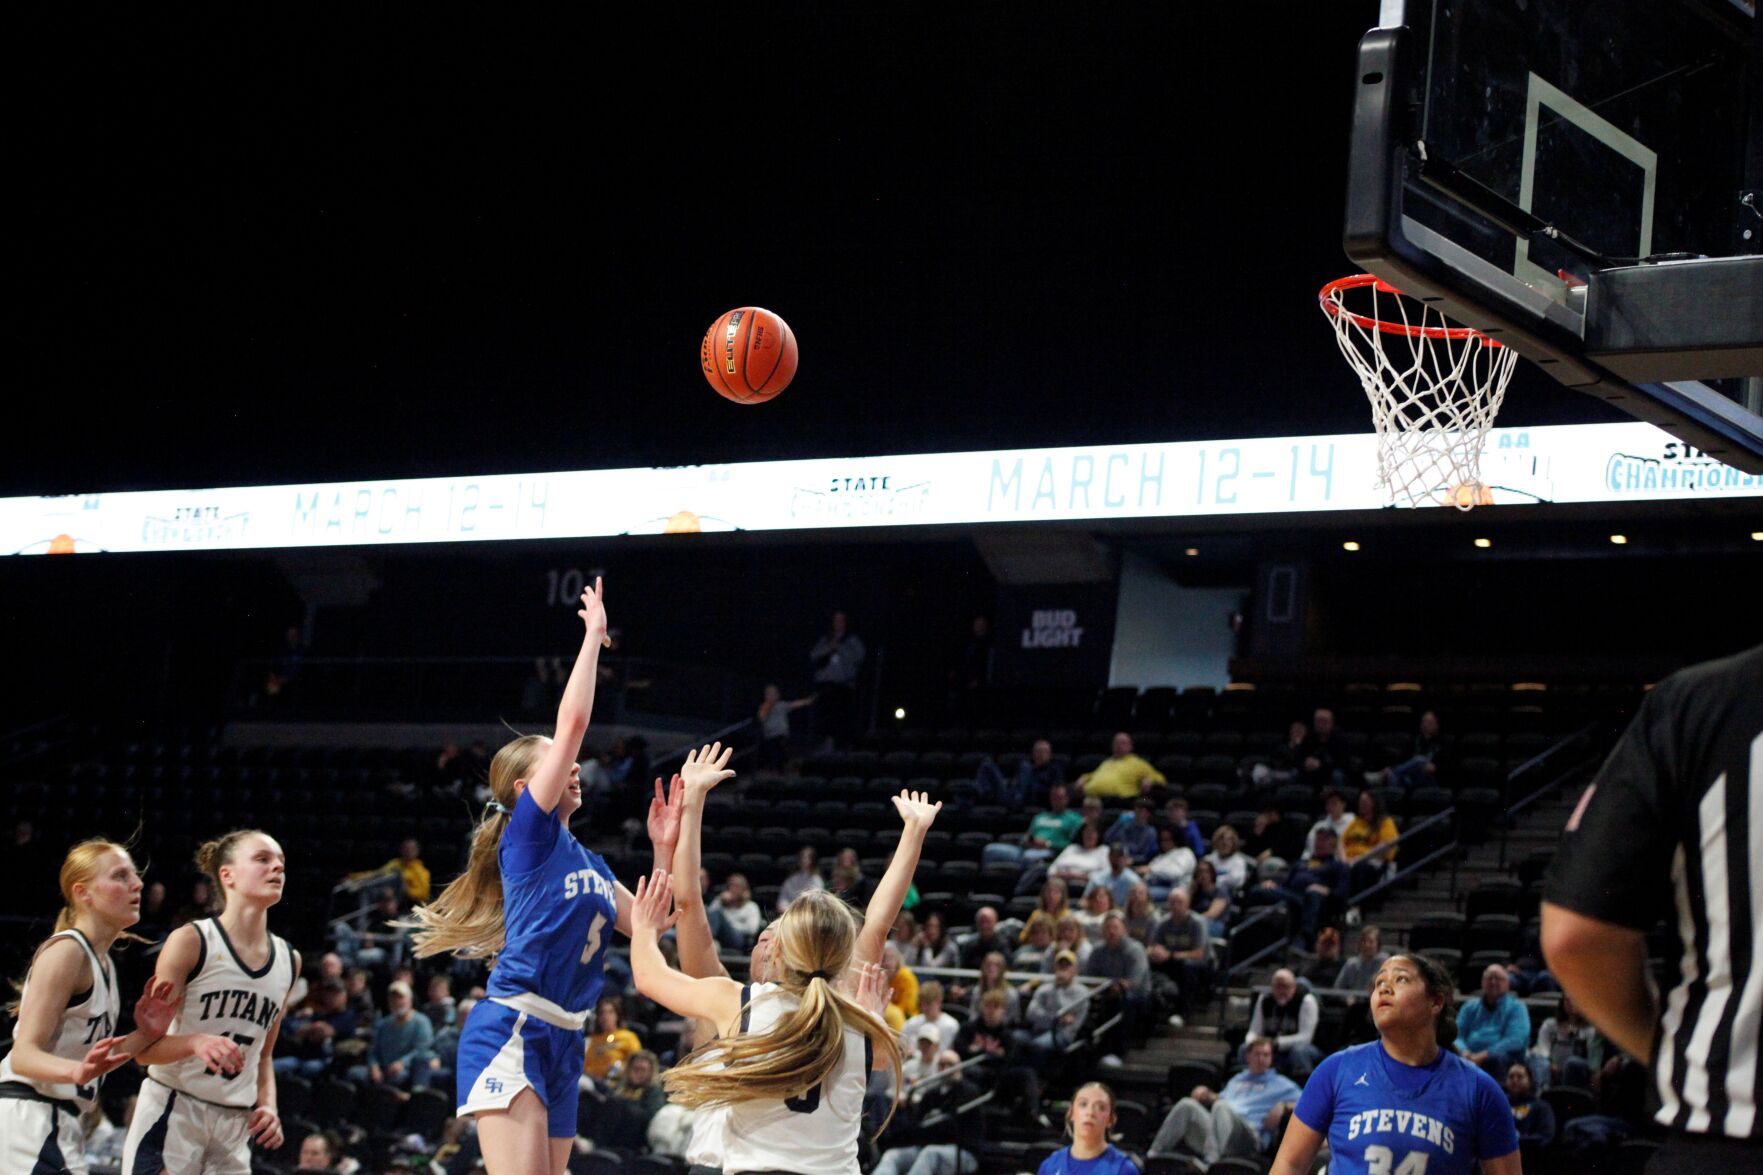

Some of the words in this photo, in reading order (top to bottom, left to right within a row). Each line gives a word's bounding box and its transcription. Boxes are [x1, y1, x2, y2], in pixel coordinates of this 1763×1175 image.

[830, 476, 891, 492] STATE
[987, 451, 1166, 512] MARCH
[1196, 442, 1335, 505] 12-14
[290, 487, 424, 536] MARCH
[447, 481, 549, 533] 12-14
[1021, 628, 1083, 648] LIGHT
[1347, 1108, 1455, 1155] STEVENS
